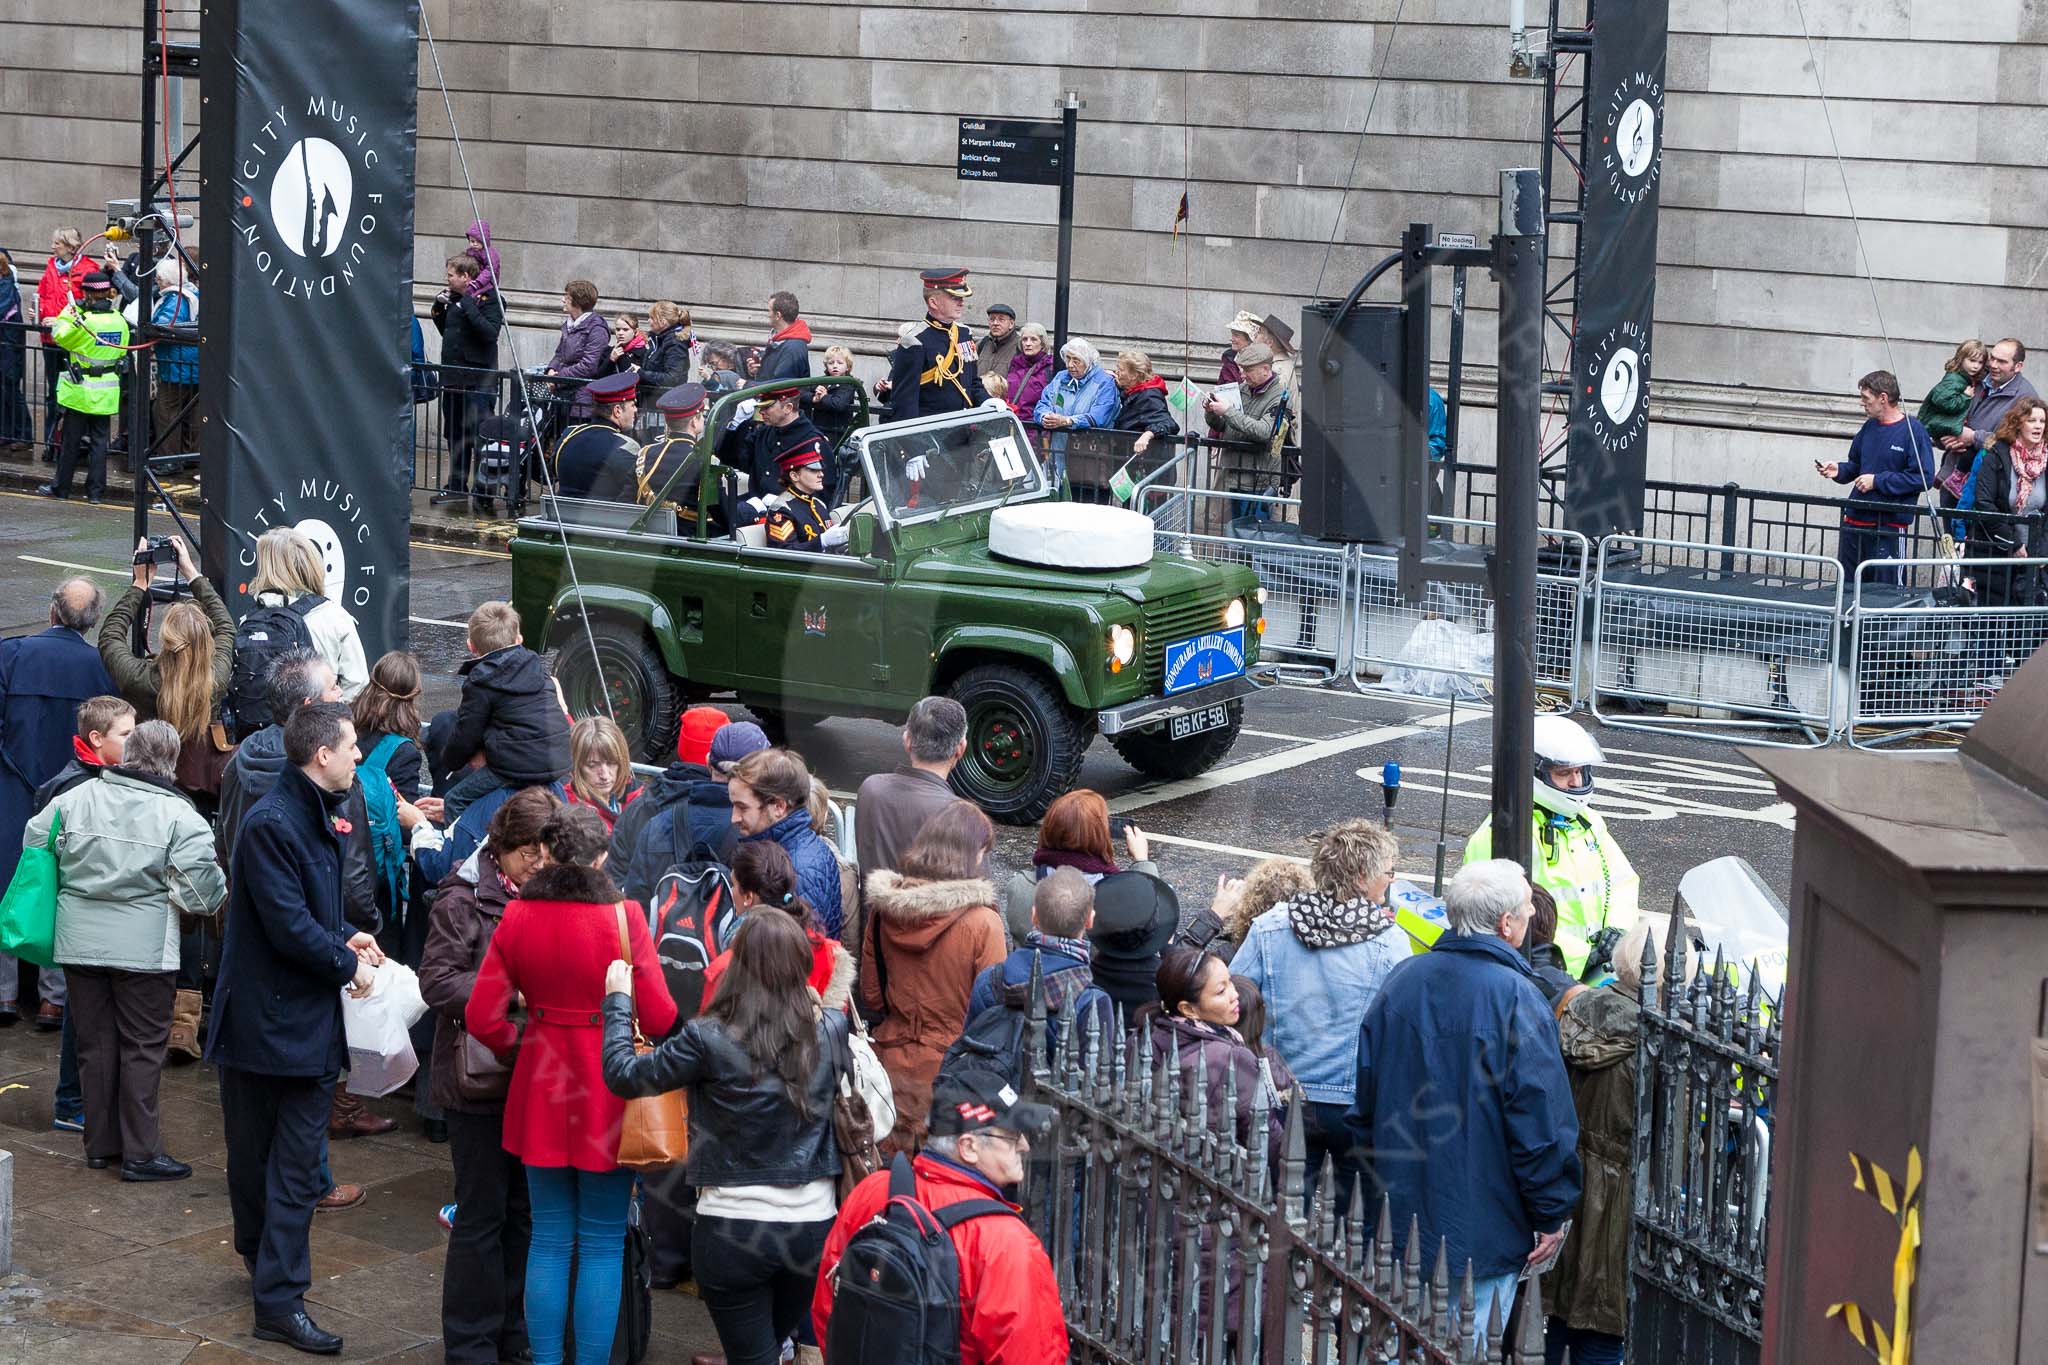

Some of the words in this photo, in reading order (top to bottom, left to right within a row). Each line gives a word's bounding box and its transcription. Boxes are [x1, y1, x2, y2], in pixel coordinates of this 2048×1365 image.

[1607, 78, 1628, 126] CITY
[1635, 71, 1664, 119] MUSIC
[243, 105, 287, 179] CITY
[307, 96, 379, 169] MUSIC
[961, 153, 982, 161] Barbican
[983, 154, 1001, 162] Centre
[968, 138, 992, 147] Margaret
[992, 139, 1017, 149] Lothbury
[961, 168, 981, 177] Chicago
[982, 169, 998, 177] Booth
[243, 193, 382, 300] FOUNDATION
[1452, 236, 1473, 245] loading
[1588, 328, 1616, 376] CITY
[1622, 320, 1651, 366] MUSIC
[1002, 447, 1014, 471] 1
[239, 491, 286, 566] CITY
[299, 478, 370, 544] MUSIC
[1164, 641, 1196, 692] HONOURABLE
[1197, 634, 1225, 653] ARTILLERY
[1223, 639, 1245, 672] COMPANY
[1174, 715, 1191, 736] 66
[1191, 710, 1207, 732] KF
[1208, 705, 1224, 727] 58
